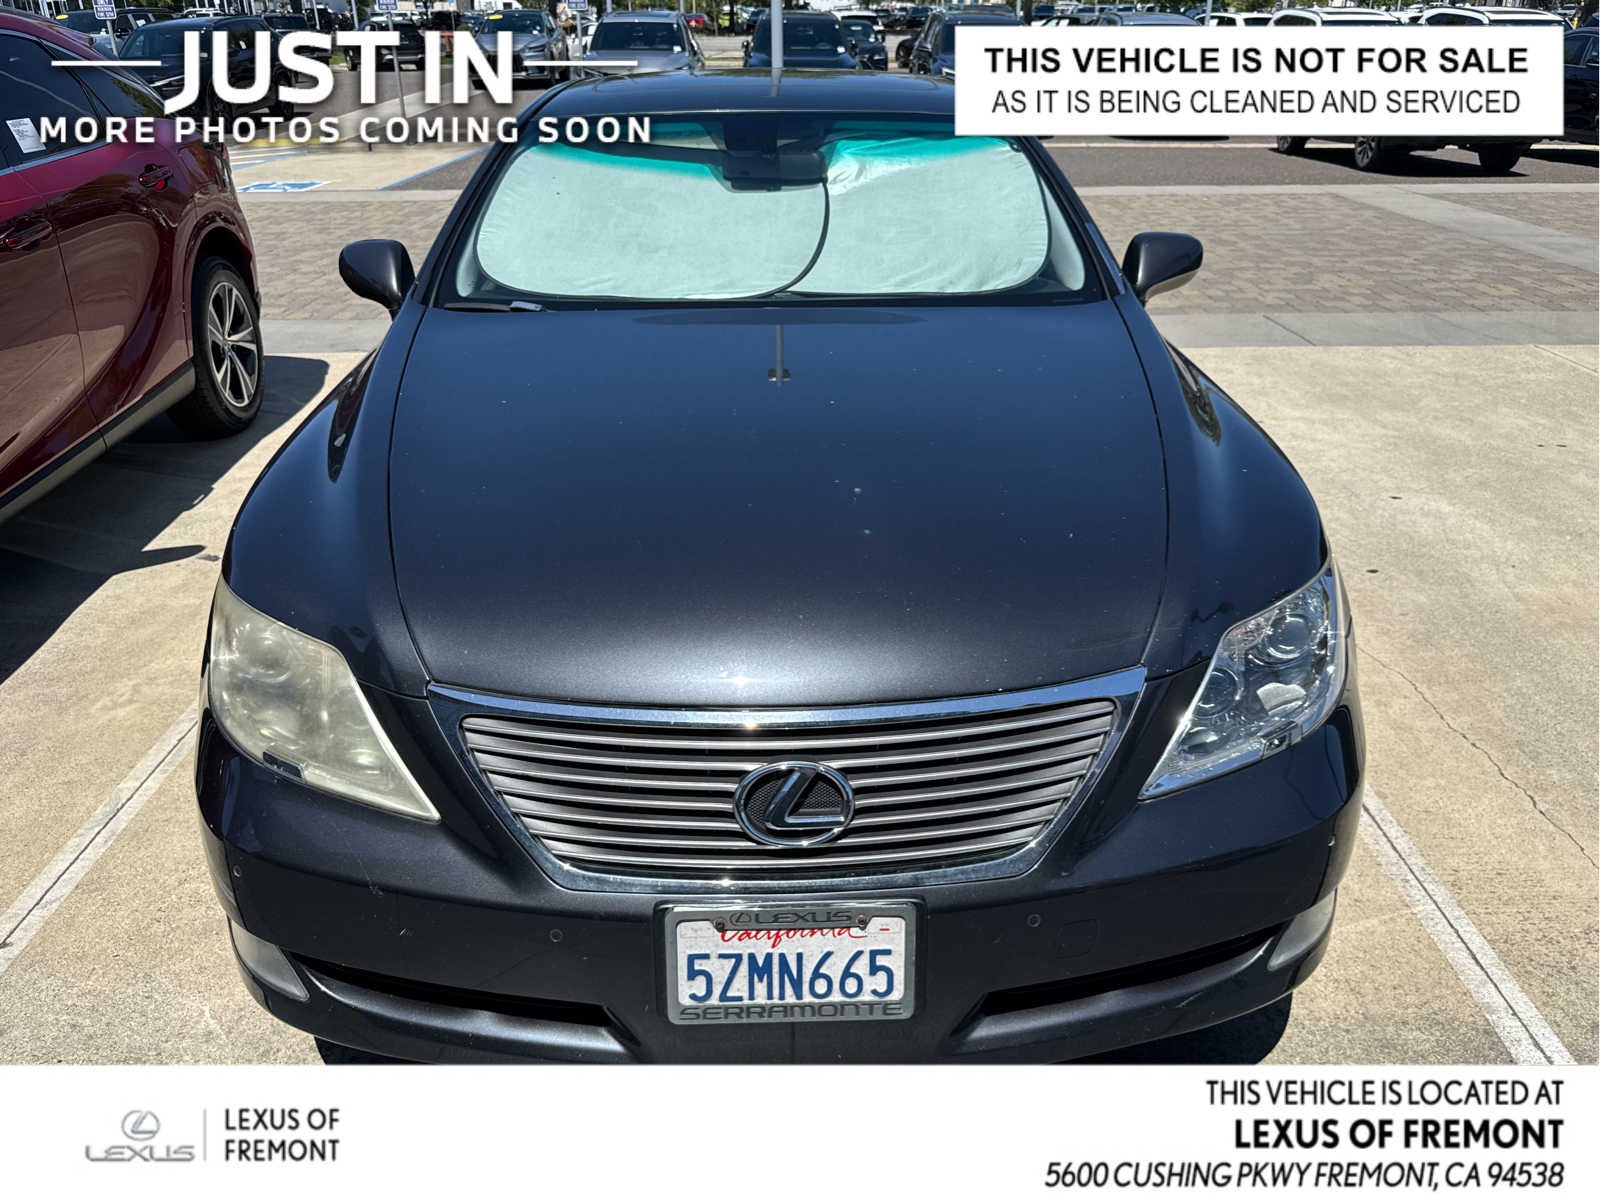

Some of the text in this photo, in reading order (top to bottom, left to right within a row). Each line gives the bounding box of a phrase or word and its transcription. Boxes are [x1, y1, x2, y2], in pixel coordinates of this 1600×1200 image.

[755, 910, 853, 924] LEXUS
[686, 949, 895, 1003] 5ZMN665
[679, 1003, 904, 1021] SERRAMONTE
